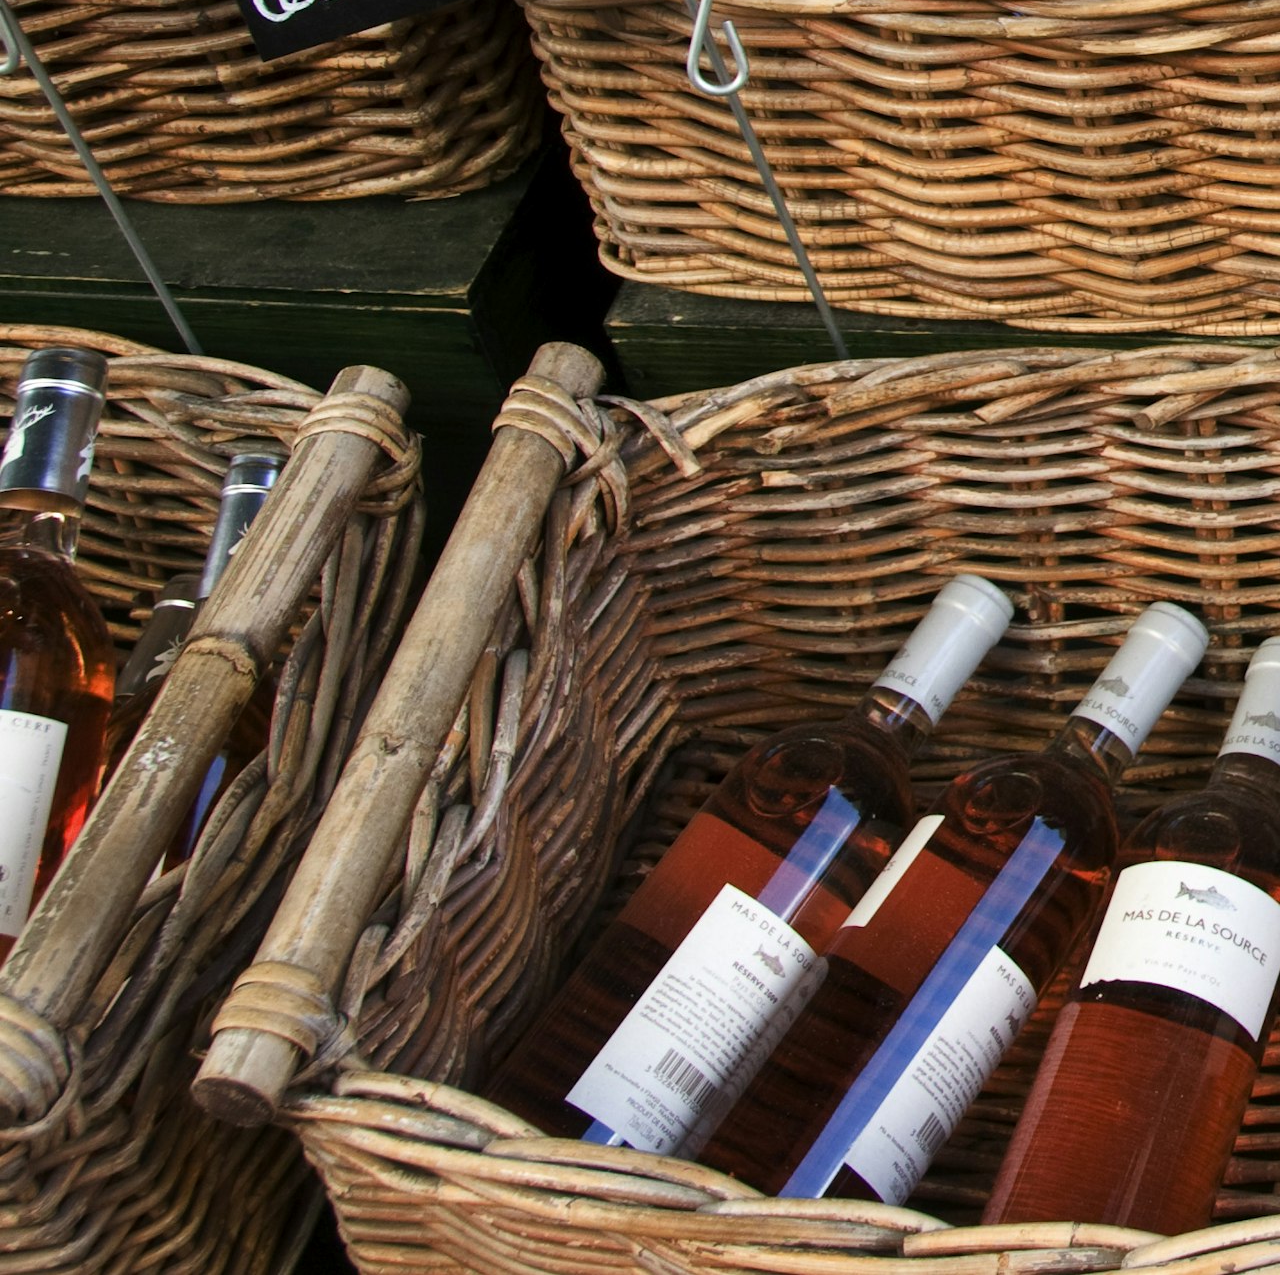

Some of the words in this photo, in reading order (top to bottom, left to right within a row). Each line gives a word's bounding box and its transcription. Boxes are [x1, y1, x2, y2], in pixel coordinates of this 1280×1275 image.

[731, 900, 759, 923] MAS
[758, 919, 777, 937] DE
[776, 933, 791, 950] LA
[1122, 909, 1154, 923] MAS
[1158, 909, 1182, 923] DE
[1184, 914, 1206, 931] LA
[1210, 923, 1269, 968] SOURCE
[996, 964, 1017, 987] MAS
